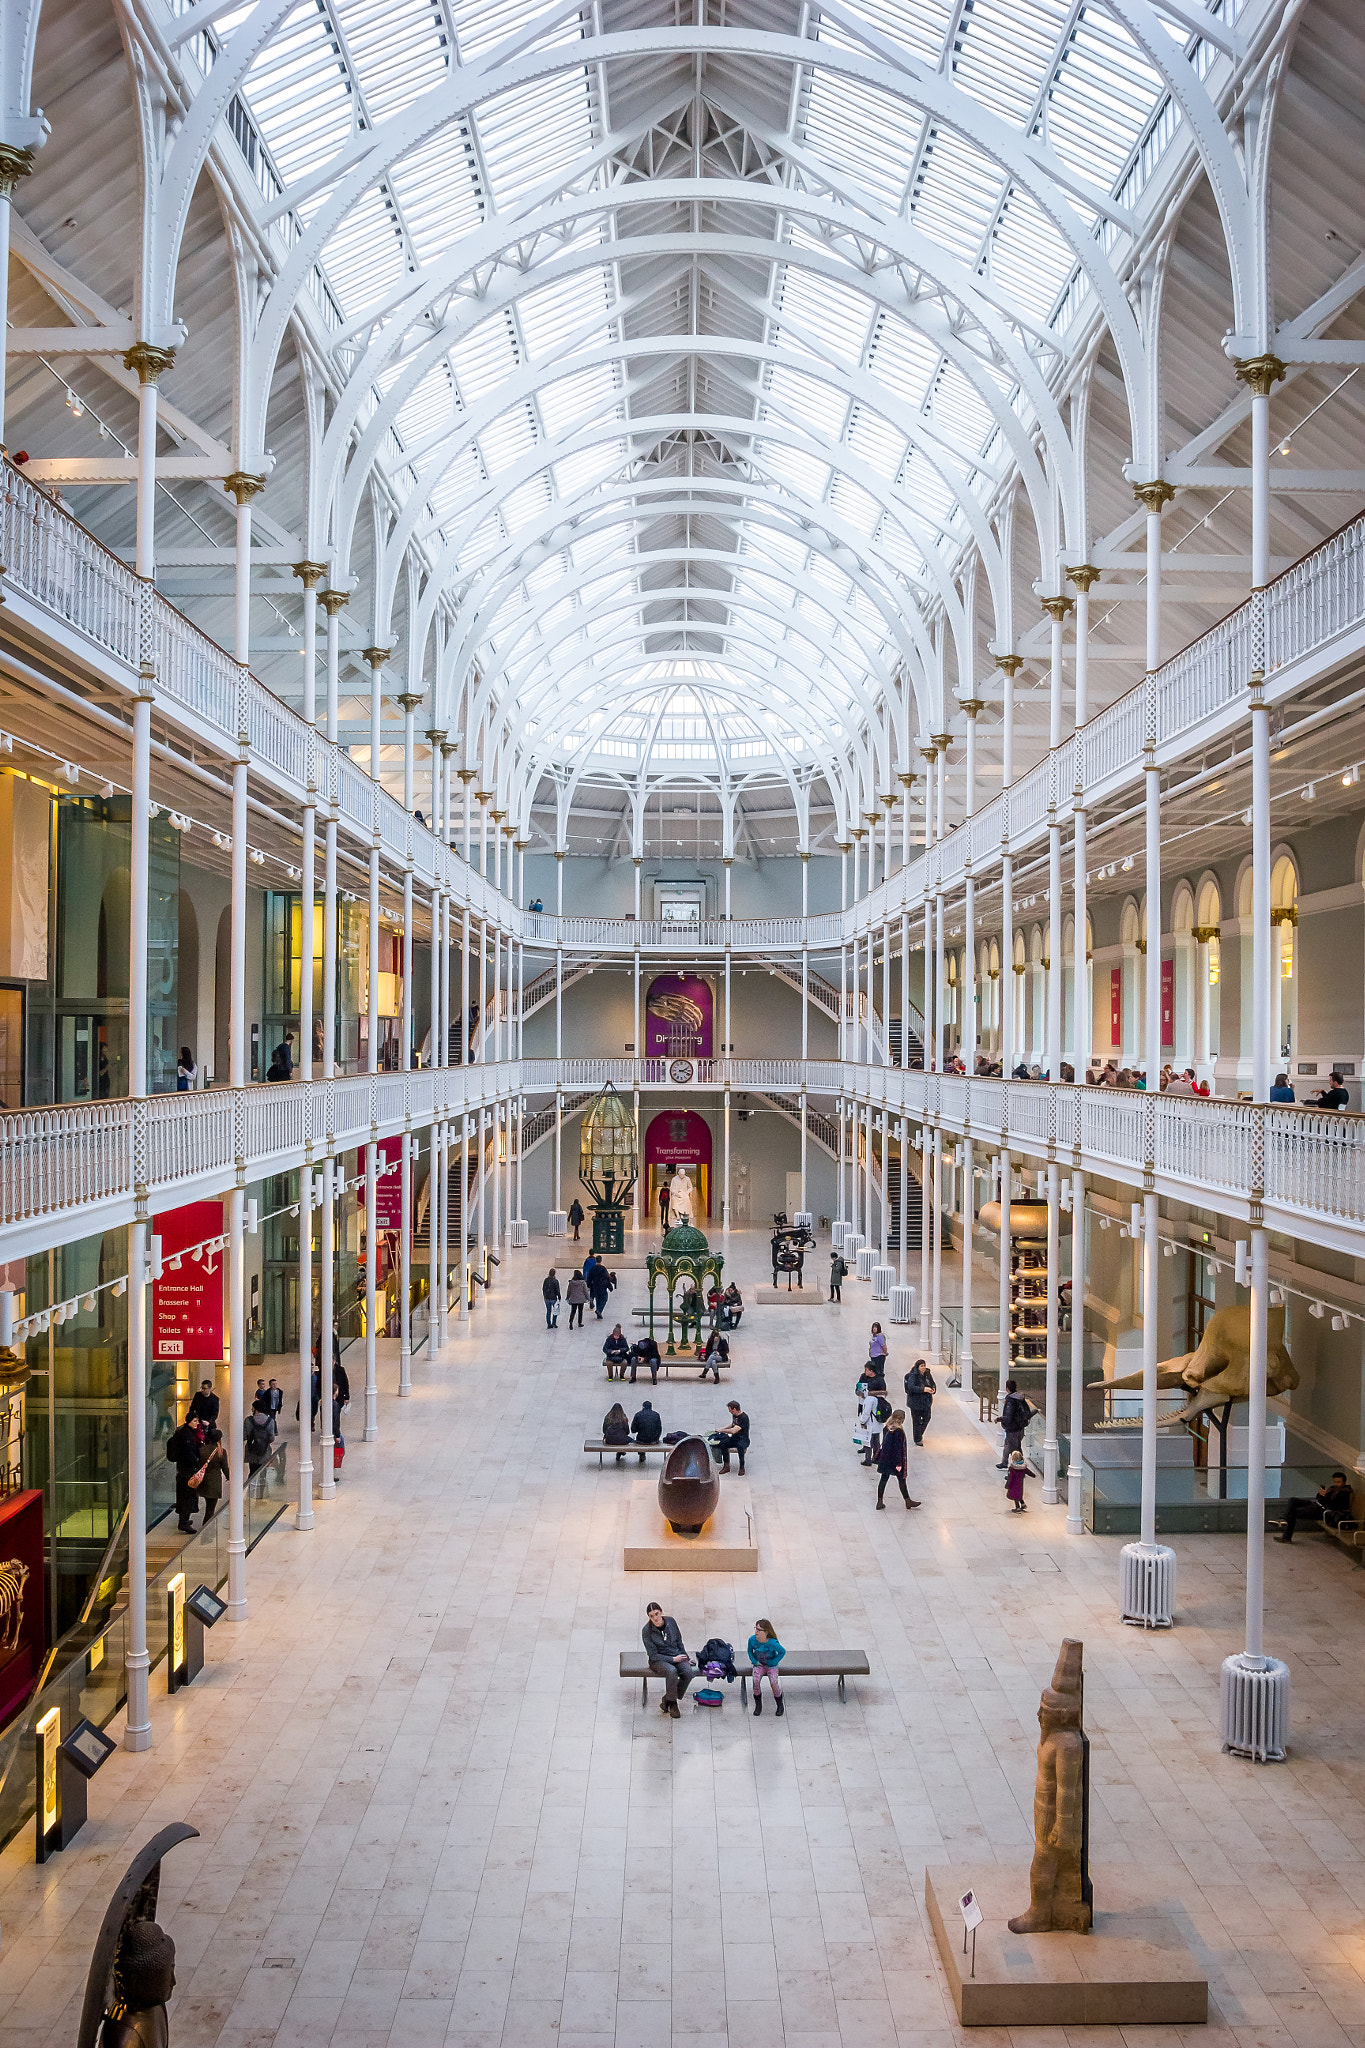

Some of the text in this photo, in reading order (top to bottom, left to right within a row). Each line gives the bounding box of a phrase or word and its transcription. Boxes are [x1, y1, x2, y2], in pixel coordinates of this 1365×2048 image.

[655, 1147, 701, 1156] Transforming
[158, 1313, 176, 1321] Shop
[161, 1343, 181, 1352] Exit
